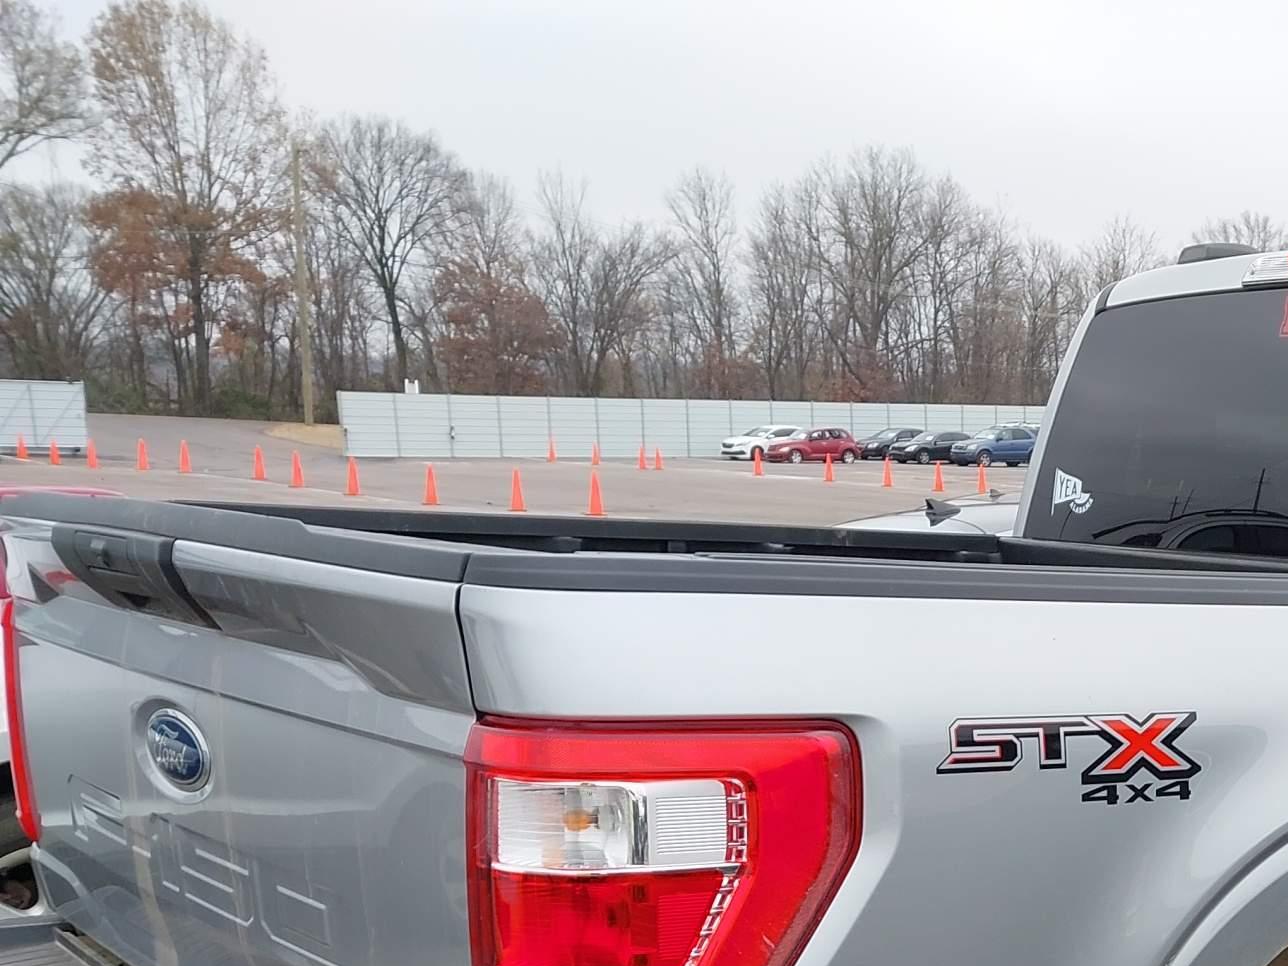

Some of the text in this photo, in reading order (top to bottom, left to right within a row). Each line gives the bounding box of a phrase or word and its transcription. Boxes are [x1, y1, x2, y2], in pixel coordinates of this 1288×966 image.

[1059, 474, 1079, 500] YEA
[154, 723, 196, 775] Ford
[936, 711, 1201, 784] STX
